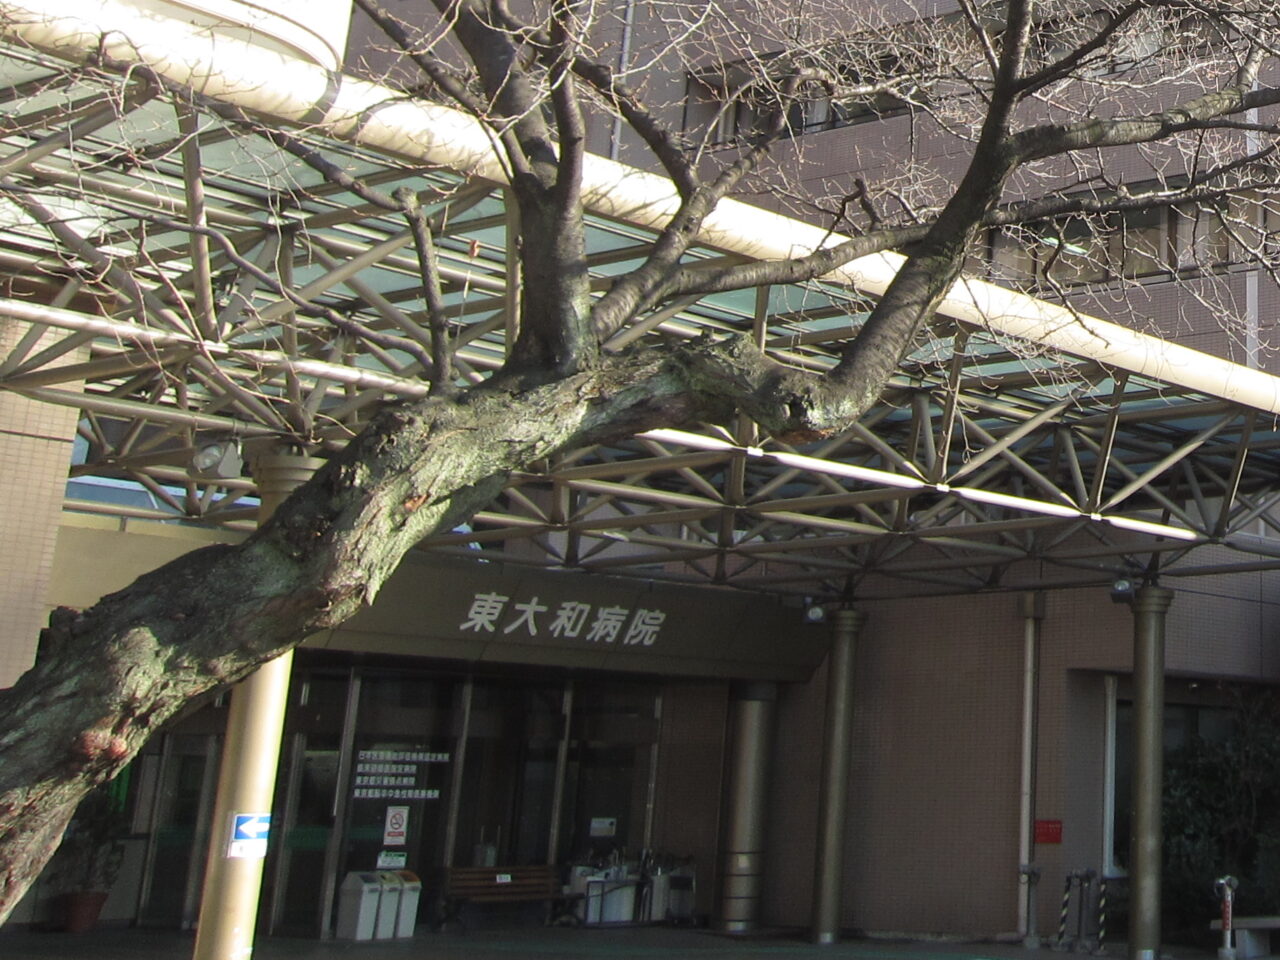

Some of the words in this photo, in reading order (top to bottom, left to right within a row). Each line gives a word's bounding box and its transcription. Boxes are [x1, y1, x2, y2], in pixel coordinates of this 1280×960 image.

[460, 592, 666, 646] 東大和病院
